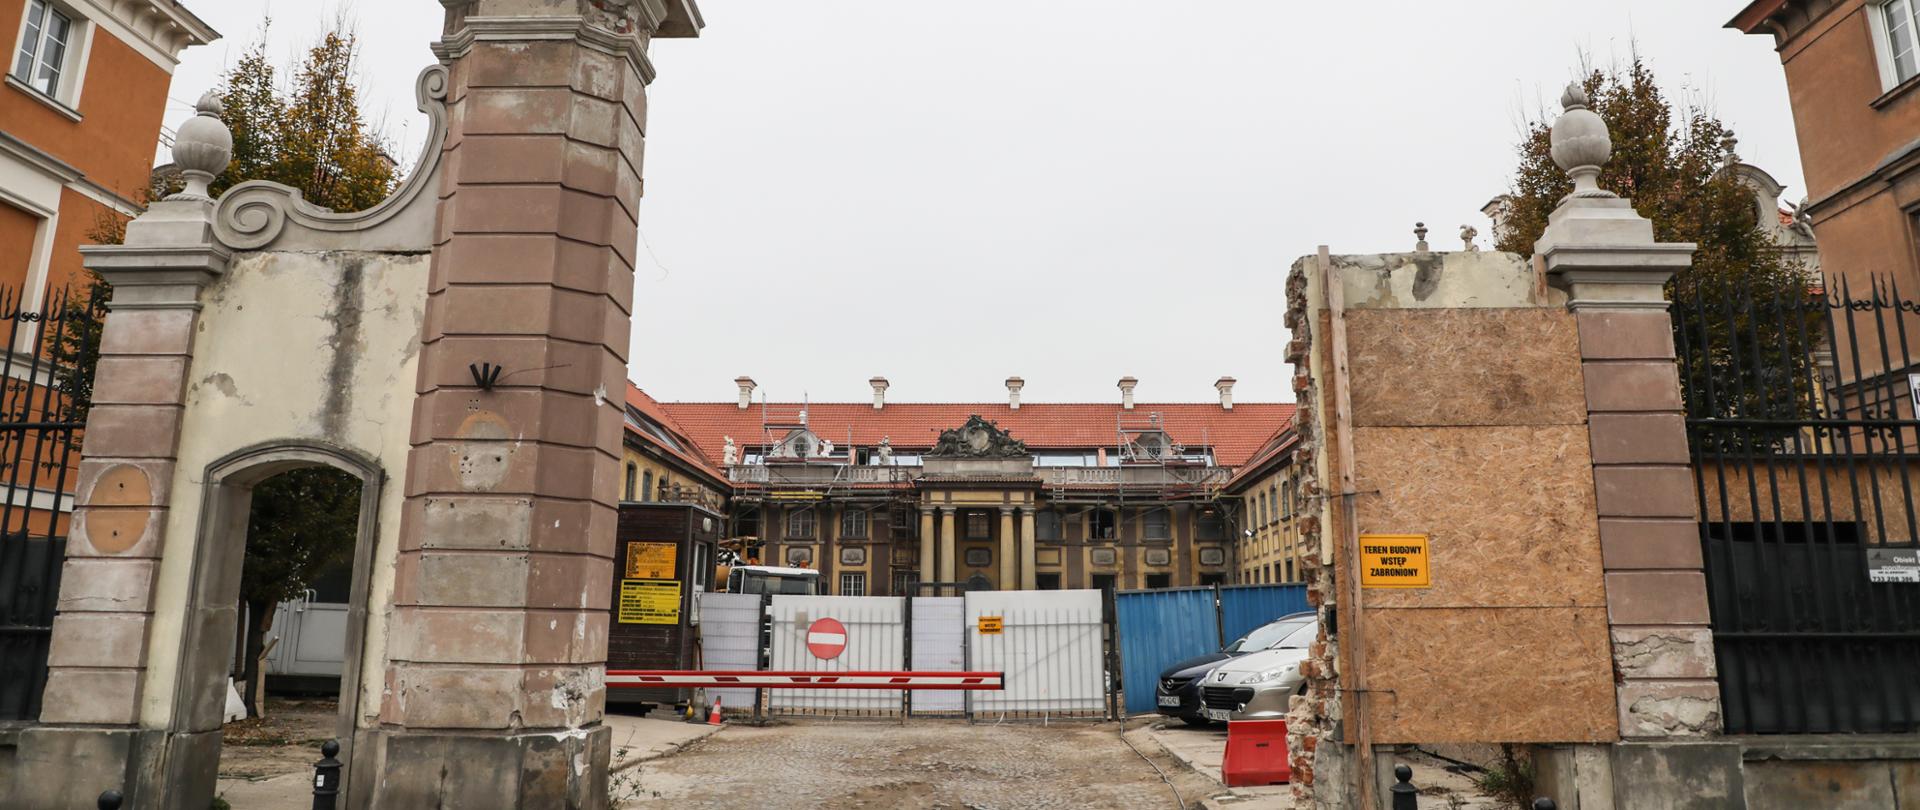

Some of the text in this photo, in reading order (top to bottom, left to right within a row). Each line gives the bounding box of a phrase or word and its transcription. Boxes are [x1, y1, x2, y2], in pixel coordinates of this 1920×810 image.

[1364, 545, 1422, 554] TEREN BUDOWY
[1380, 557, 1407, 567] WSTĘP
[1893, 556, 1916, 564] Obiekt
[1370, 568, 1418, 577] ZABRONIONY
